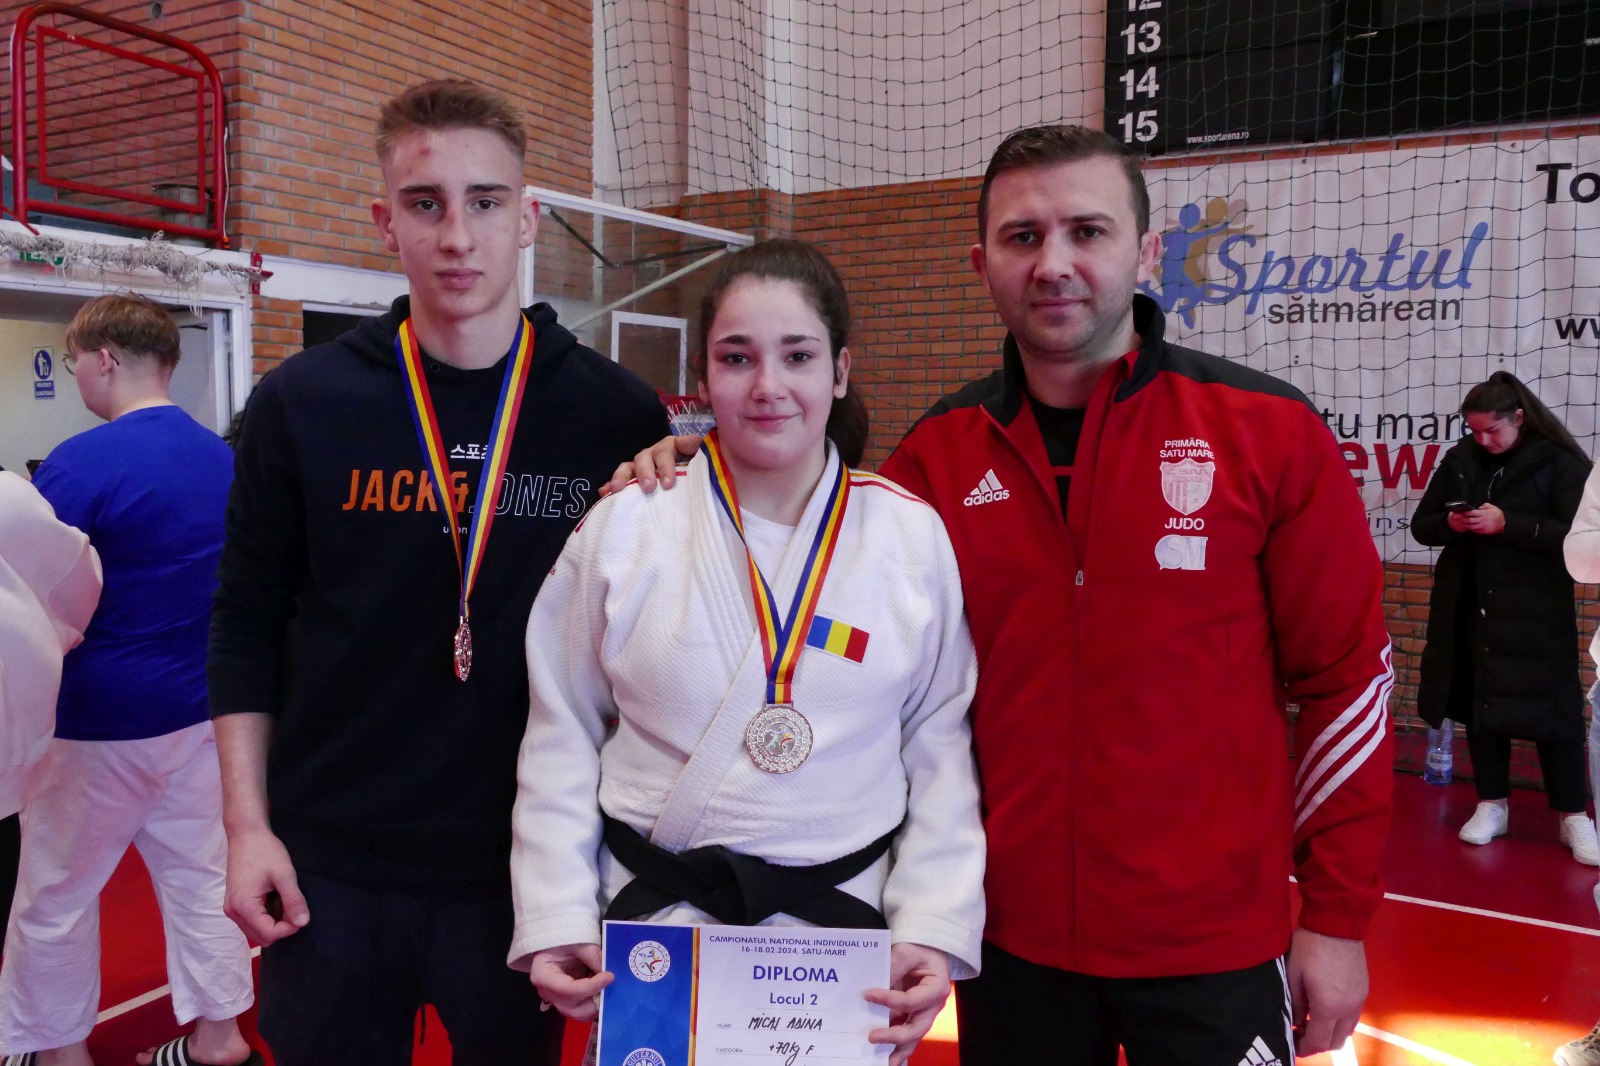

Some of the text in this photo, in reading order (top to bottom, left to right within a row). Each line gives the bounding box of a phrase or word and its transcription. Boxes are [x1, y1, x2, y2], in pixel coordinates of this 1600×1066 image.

[1120, 20, 1162, 55] 13
[1119, 66, 1160, 100] 14
[1118, 109, 1159, 144] 15
[1186, 131, 1249, 144] www.sportarena.ro
[1200, 221, 1489, 315] Sportul
[1267, 293, 1461, 325] sătmărean
[1160, 449, 1215, 460] SATU MARE
[963, 489, 1010, 506] adidas
[1164, 517, 1205, 531] JUDO
[709, 935, 879, 949] CAMPIONATUL NATIONAL INDIVIDUAL U18
[741, 945, 847, 956] 16-18.02.2024, SATU-MARE
[753, 965, 839, 983] DIPLOMA
[769, 992, 818, 1006] Locul 2
